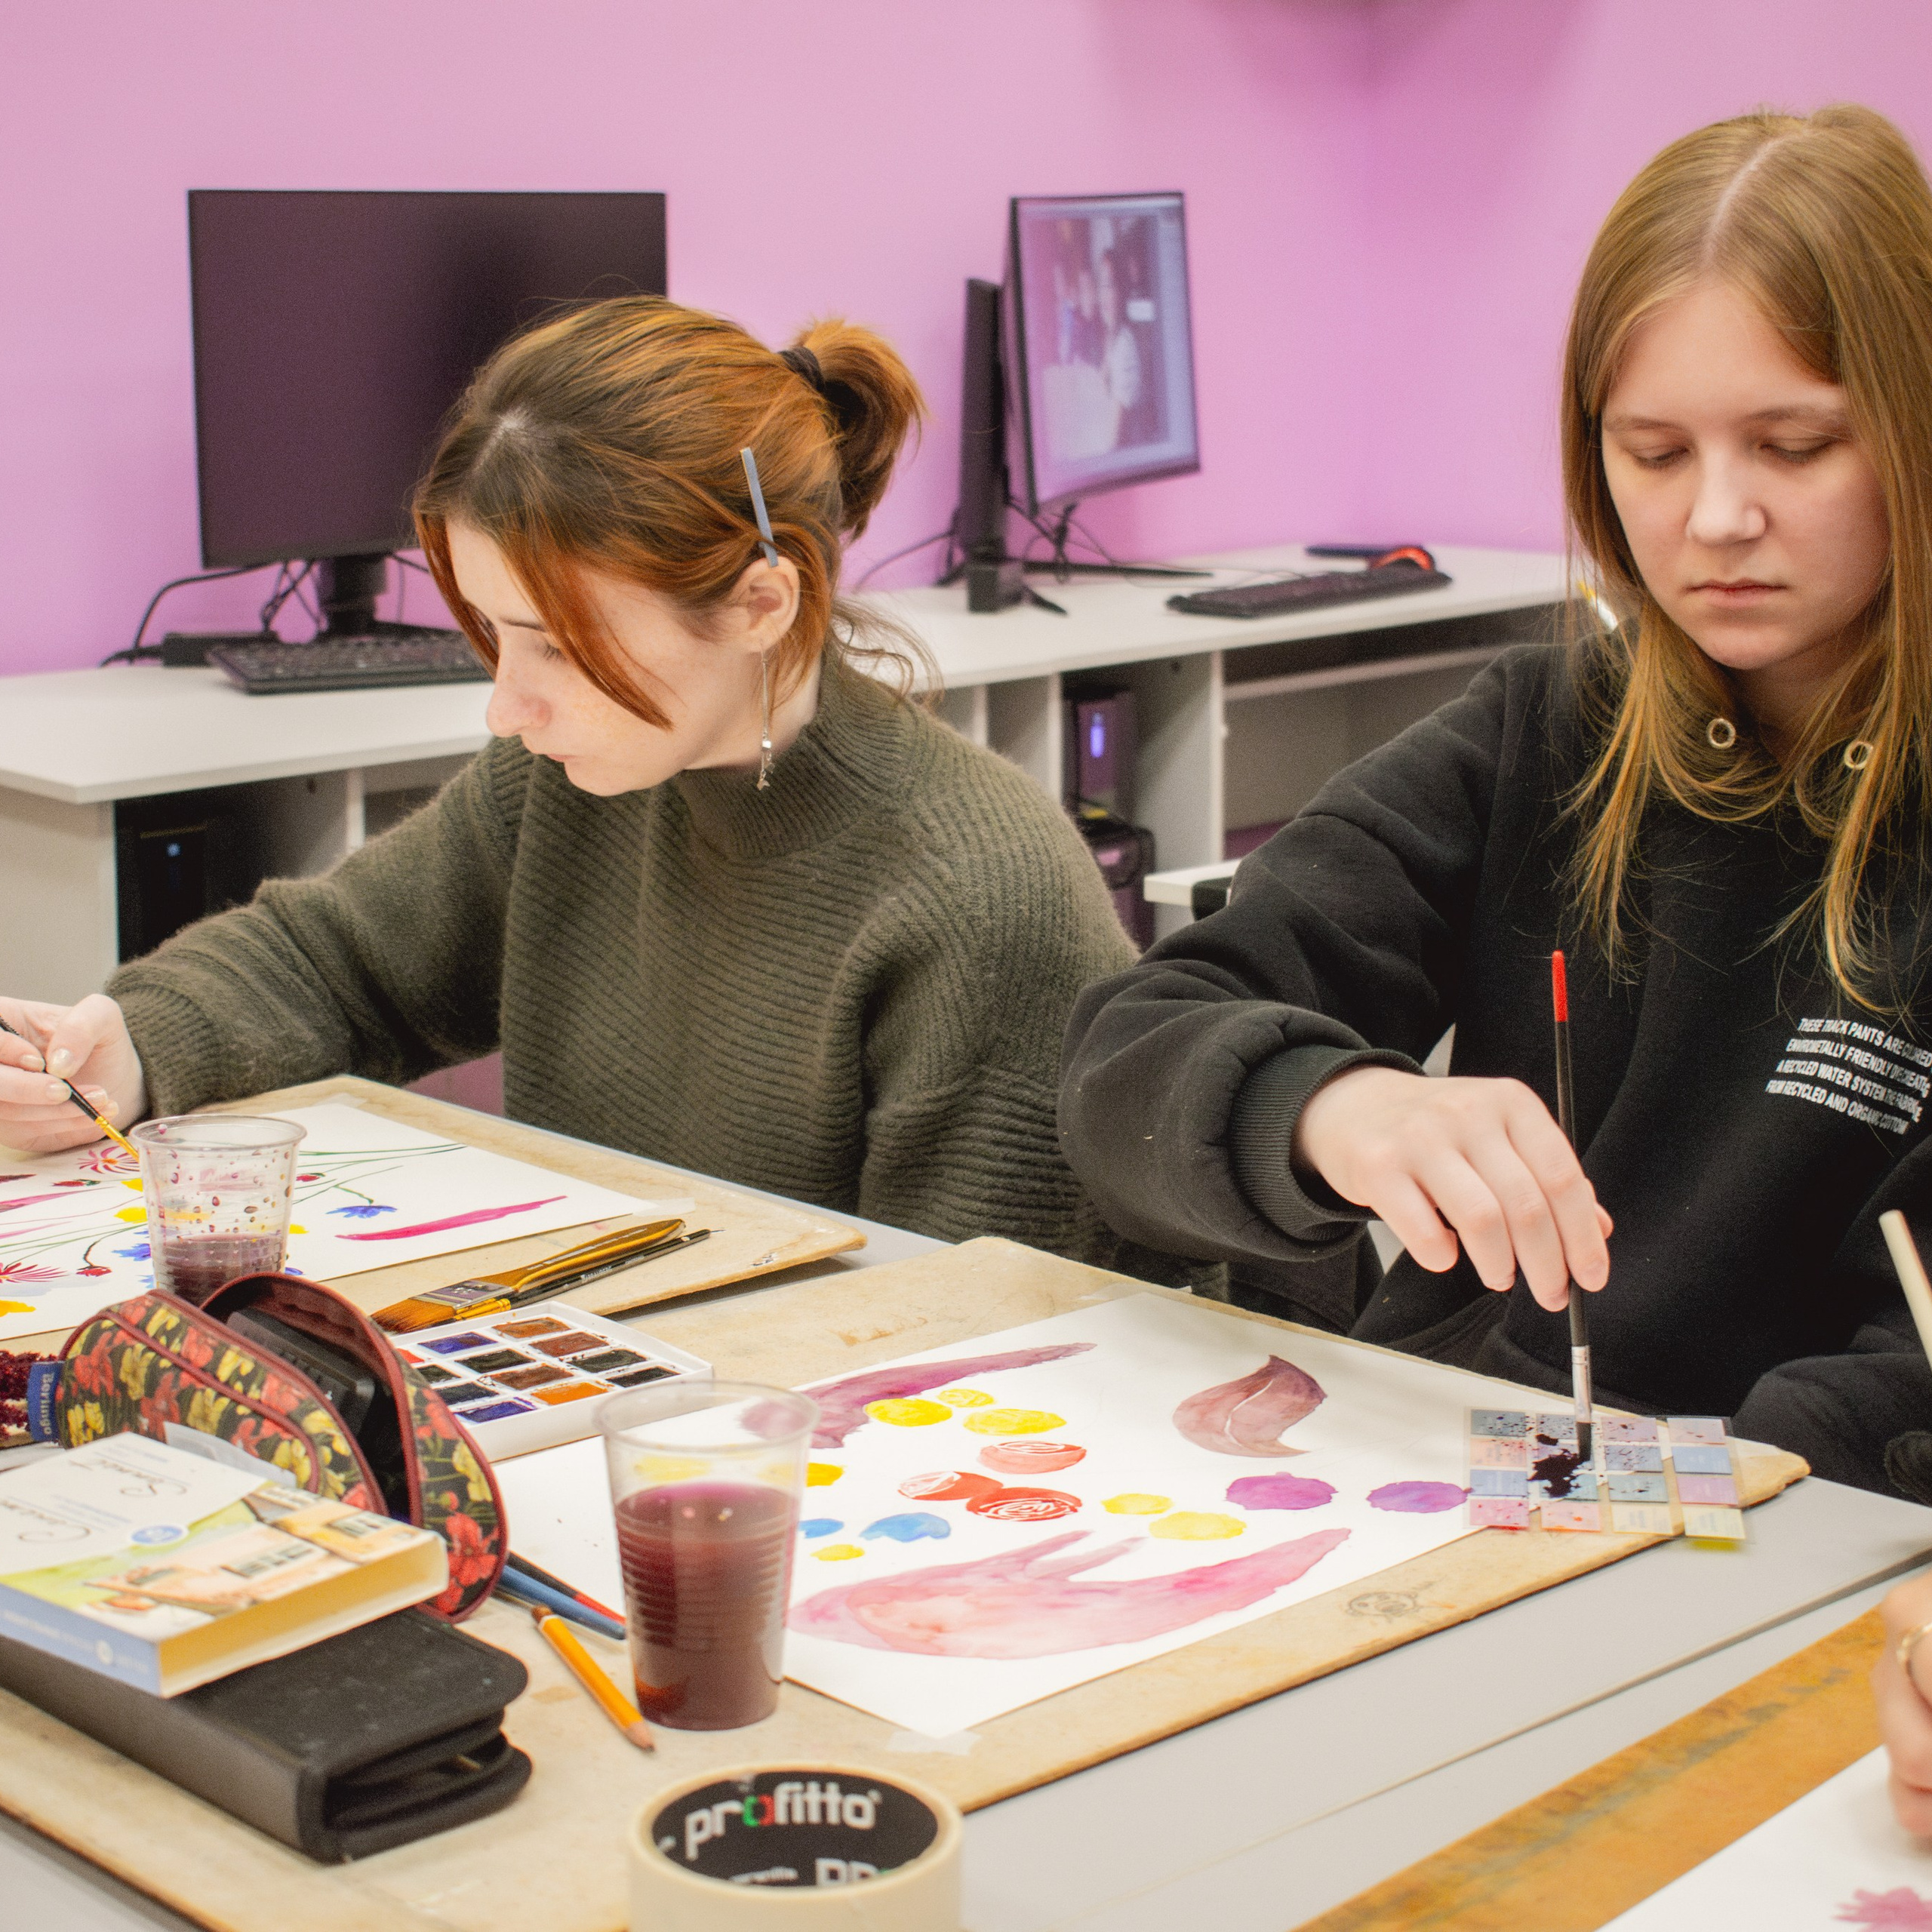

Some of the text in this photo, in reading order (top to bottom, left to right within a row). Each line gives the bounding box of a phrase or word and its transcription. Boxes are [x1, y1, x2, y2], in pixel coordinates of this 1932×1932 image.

[1797, 1017, 1825, 1032] THESE
[1821, 1019, 1850, 1035] TRACK
[1847, 1022, 1885, 1047] PANTS
[1882, 1035, 1906, 1055] ARE
[1776, 1060, 1785, 1072] A
[1782, 1060, 1820, 1076] RECYCLED
[1817, 1063, 1853, 1088] WATER
[1850, 1075, 1887, 1101] SYSTEM
[1844, 1046, 1894, 1076] FRIENDLY
[1764, 1079, 1786, 1094] FROM
[1782, 1081, 1827, 1104] RECYCLED
[1824, 1092, 1849, 1112] AND
[1847, 1101, 1884, 1126] ORGANIC
[39, 1372, 54, 1435] Berlingo
[685, 1781, 876, 1861] profitto
